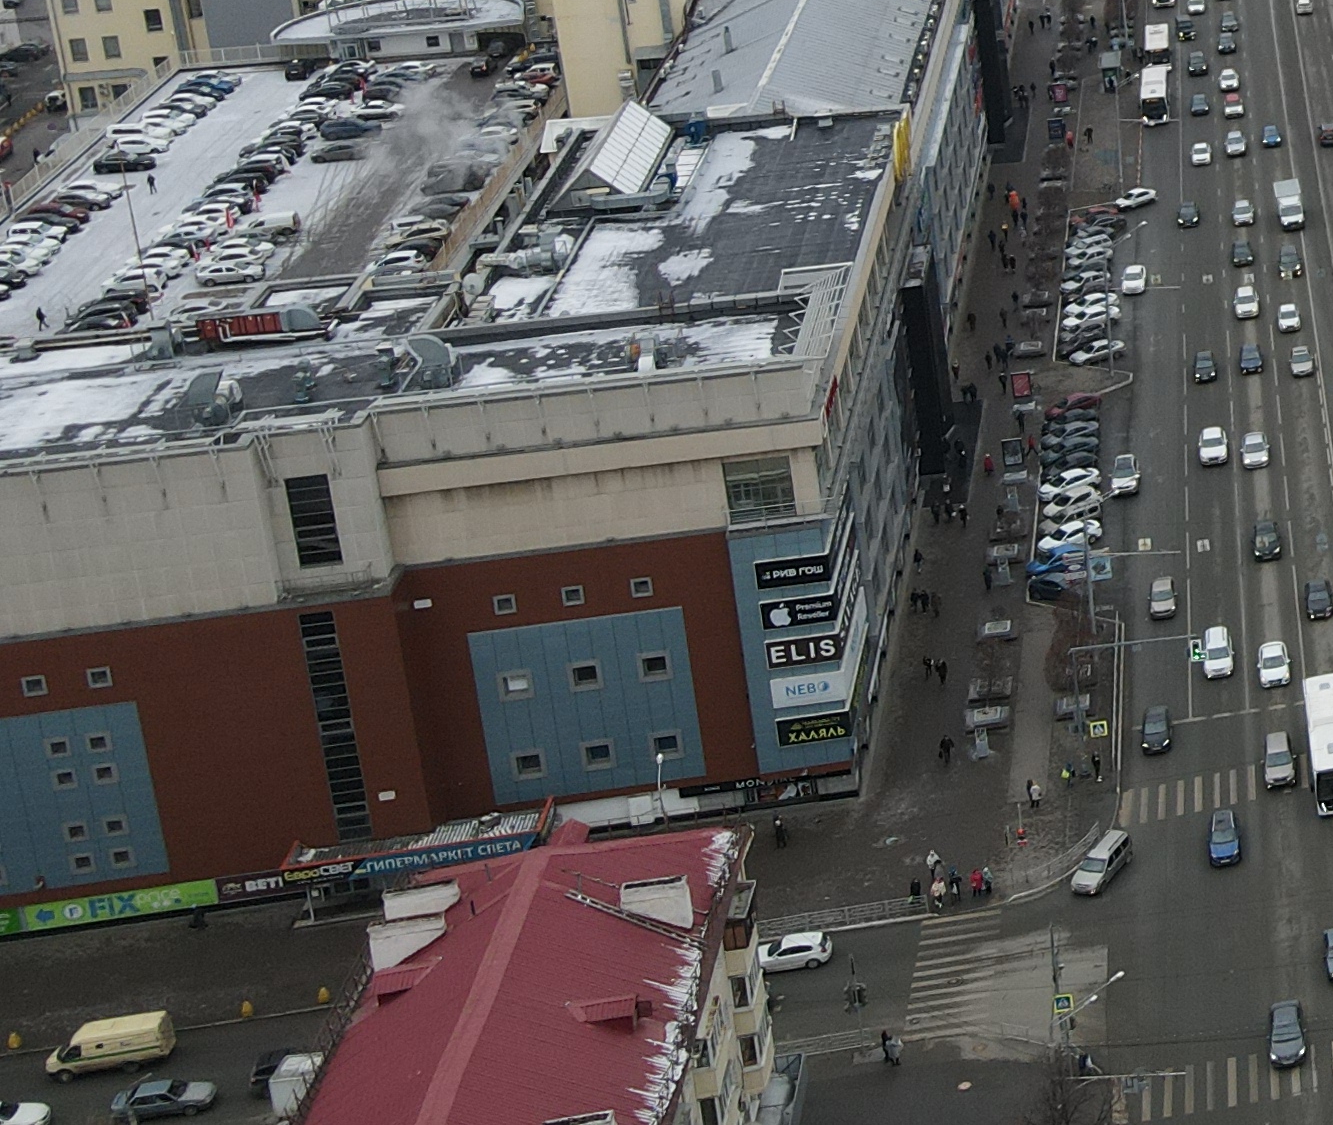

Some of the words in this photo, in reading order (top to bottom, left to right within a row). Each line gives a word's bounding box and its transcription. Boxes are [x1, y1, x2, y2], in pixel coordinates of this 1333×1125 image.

[772, 568, 797, 579] РИВ
[799, 565, 824, 576] ГОШ
[795, 600, 832, 611] Premium
[797, 609, 830, 621] Reseller
[769, 639, 836, 664] ELIS
[788, 726, 846, 743] ХАЛЯЛЬ
